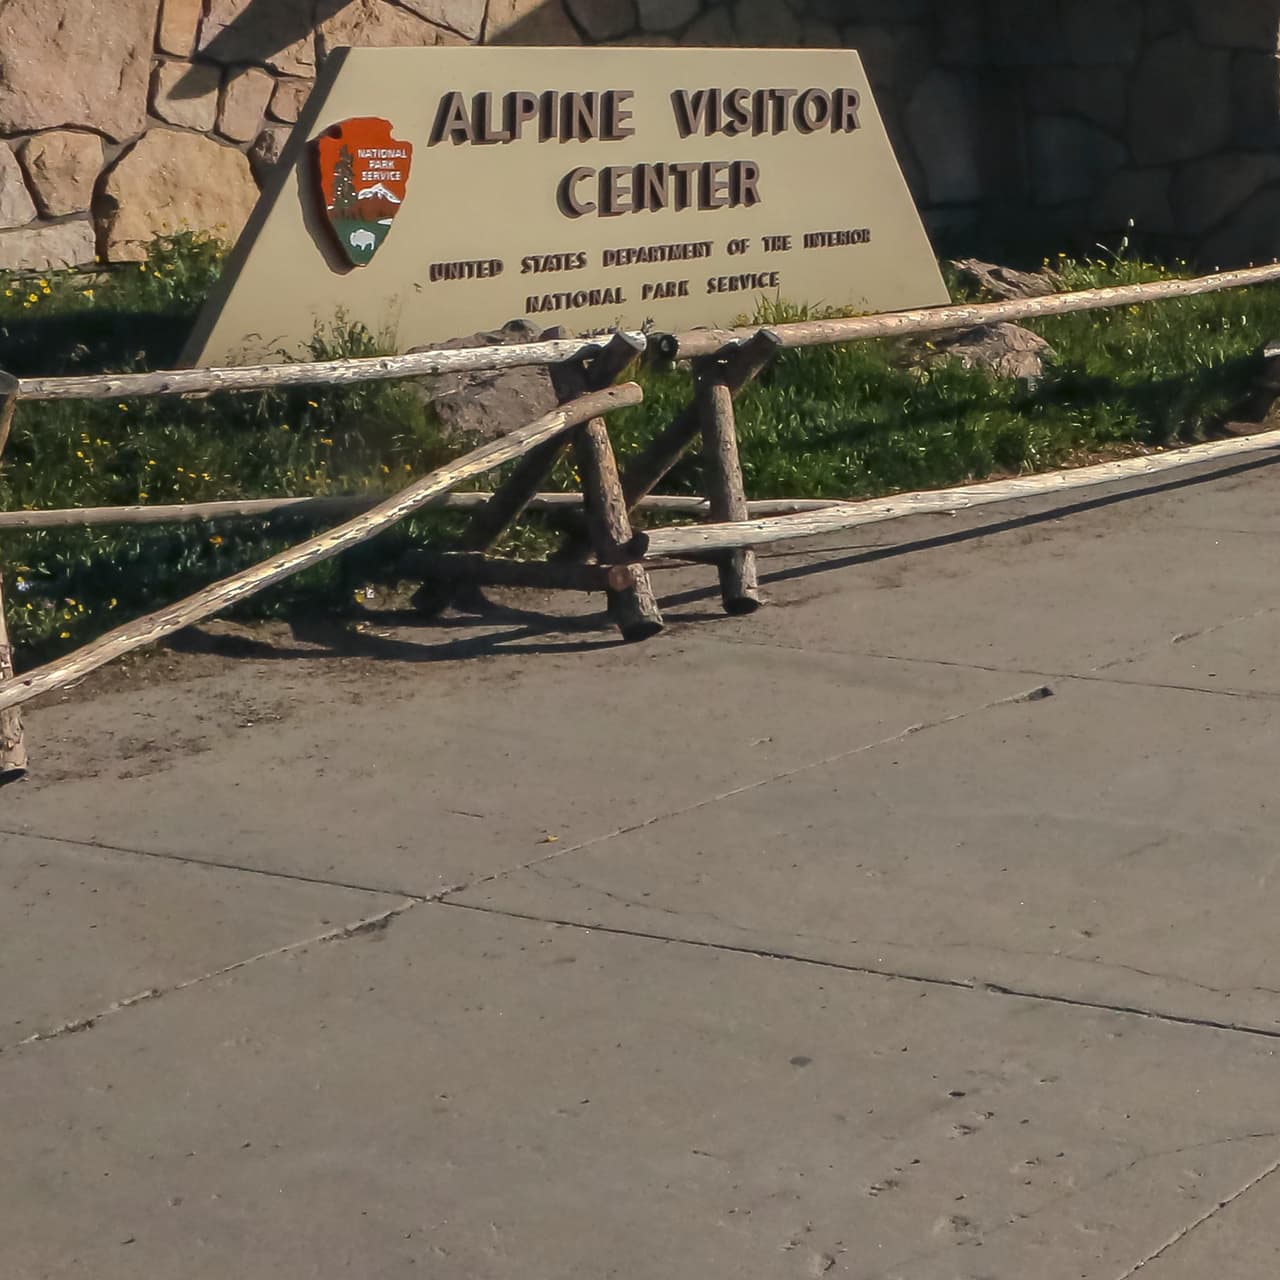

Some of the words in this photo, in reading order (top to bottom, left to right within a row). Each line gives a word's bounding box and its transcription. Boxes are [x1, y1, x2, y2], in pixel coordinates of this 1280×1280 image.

[427, 90, 635, 147] ALPINE
[670, 88, 861, 139] VISITOR
[358, 149, 407, 158] NATIONAL
[369, 160, 394, 168] PARK
[362, 171, 401, 181] SERVICE
[556, 160, 761, 219] CENTER
[429, 259, 504, 282] UNITED
[520, 251, 587, 274] STATES
[602, 240, 714, 268] DEPARTMENT
[727, 238, 750, 255] OF
[761, 235, 792, 252] THE
[803, 228, 871, 249] INTERIOR
[525, 287, 627, 314] NATIONAL
[641, 280, 689, 300] PARK
[706, 271, 780, 294] SERVICE
